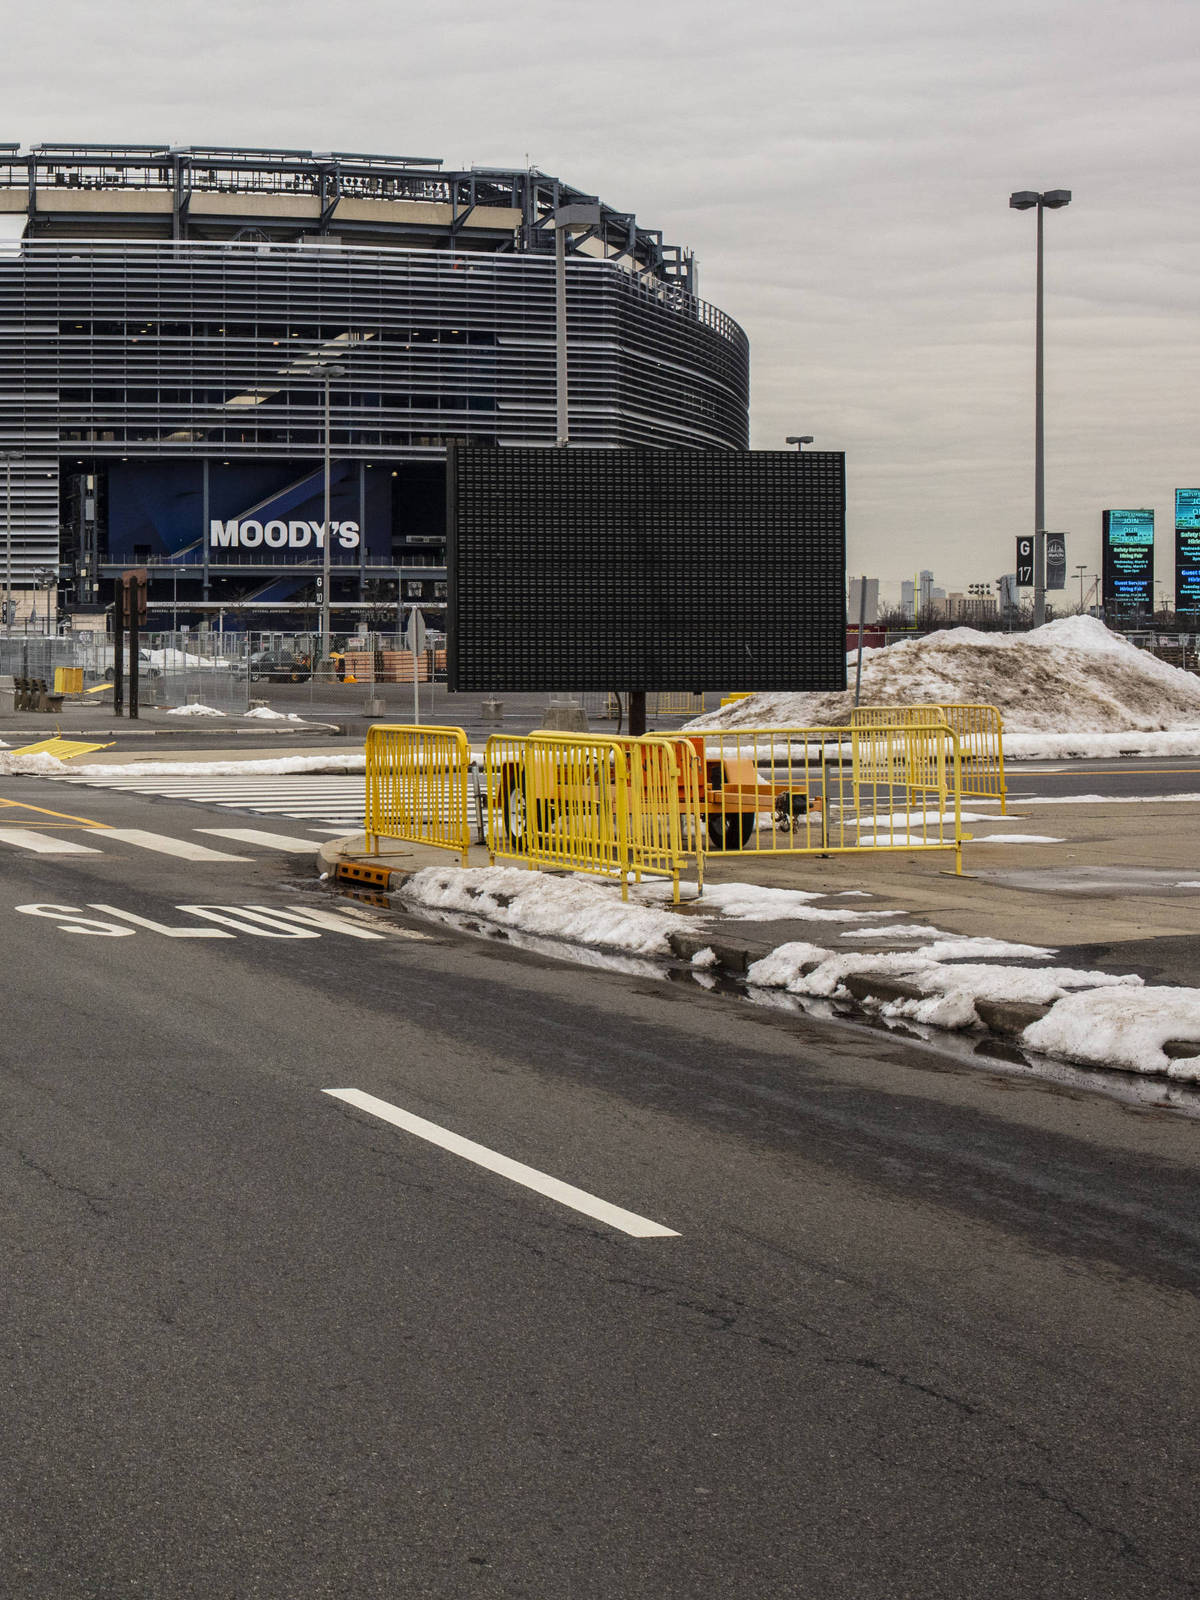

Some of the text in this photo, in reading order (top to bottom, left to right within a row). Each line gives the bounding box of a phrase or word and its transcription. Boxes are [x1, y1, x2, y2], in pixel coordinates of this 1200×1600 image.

[210, 519, 360, 549] MOODY'S
[1020, 540, 1030, 556] G
[1018, 566, 1031, 582] 17
[14, 903, 432, 940] SLOW
